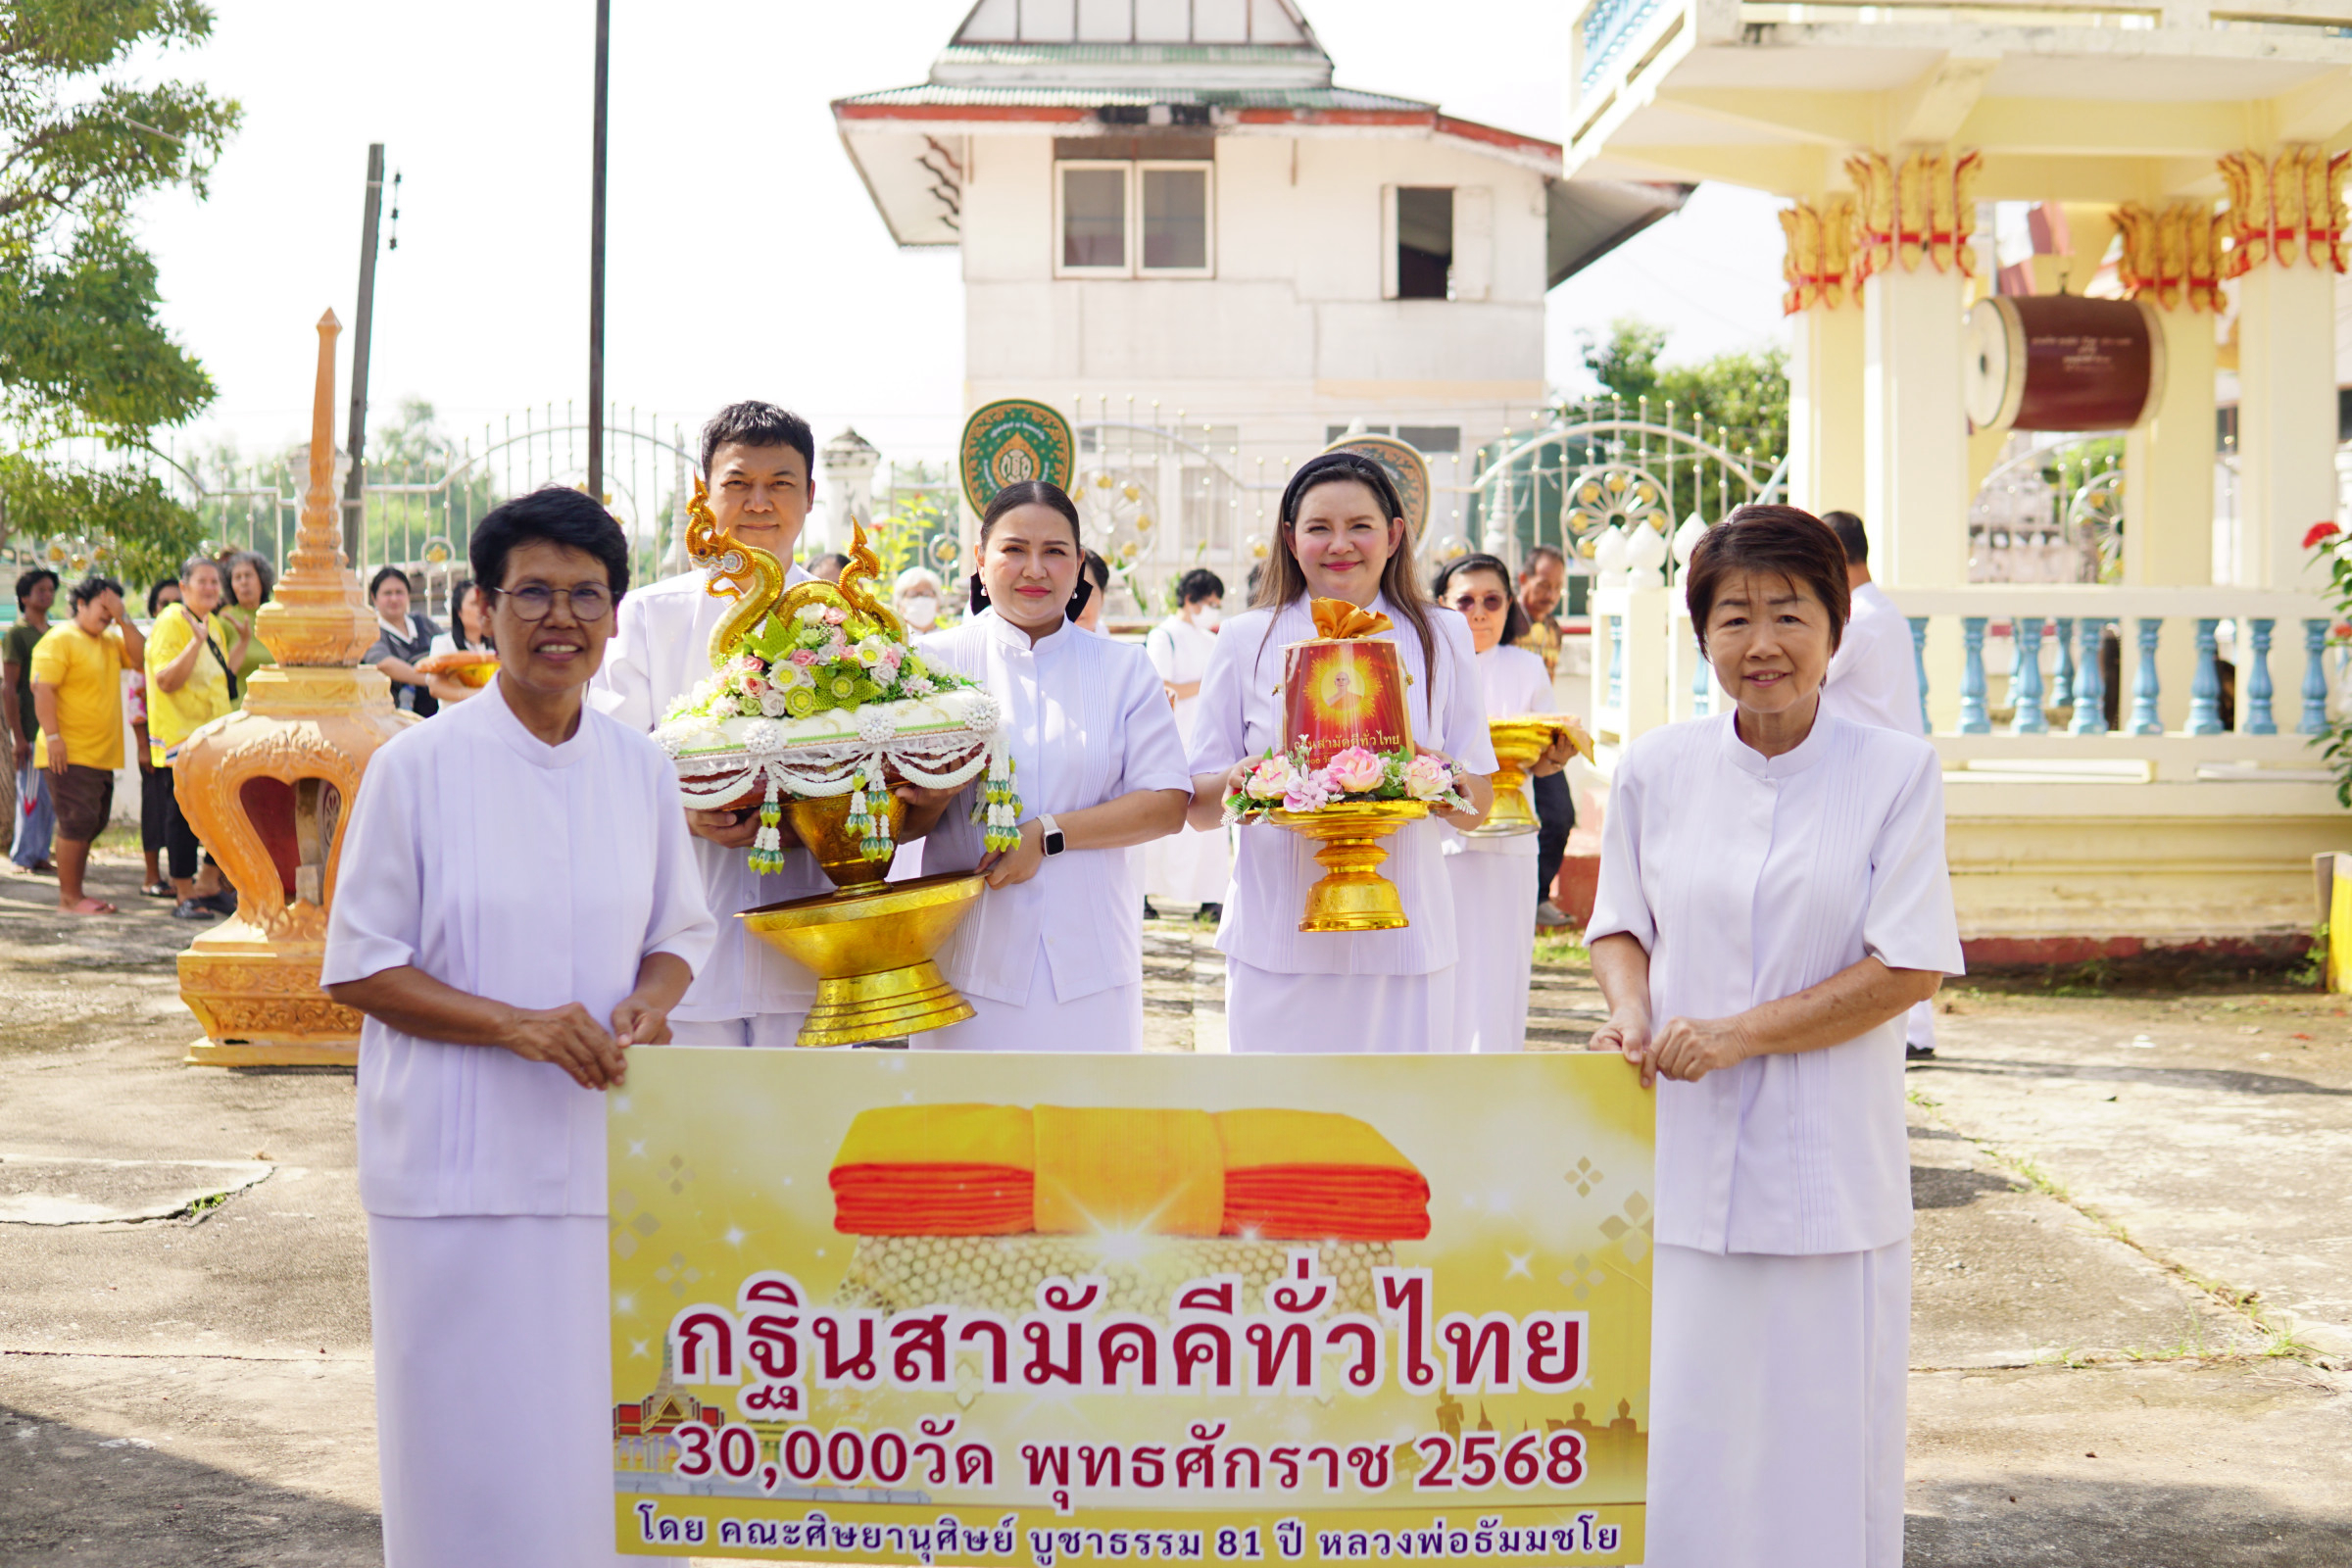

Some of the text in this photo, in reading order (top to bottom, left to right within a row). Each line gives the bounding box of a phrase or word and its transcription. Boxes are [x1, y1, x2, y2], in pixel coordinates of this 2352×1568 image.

[1294, 729, 1399, 751] กนสามัคคีทั่วไทย
[678, 1257, 1579, 1411] กฐินสามัคคีทั่วไทย
[677, 1418, 1583, 1510] 30,000วัด พุทธศักราช 2568
[637, 1504, 1618, 1566] โดย คณะศิษยานุศิษย์ บูชาธรรม 81 ปี หลวงพ่อธัมมชโย
